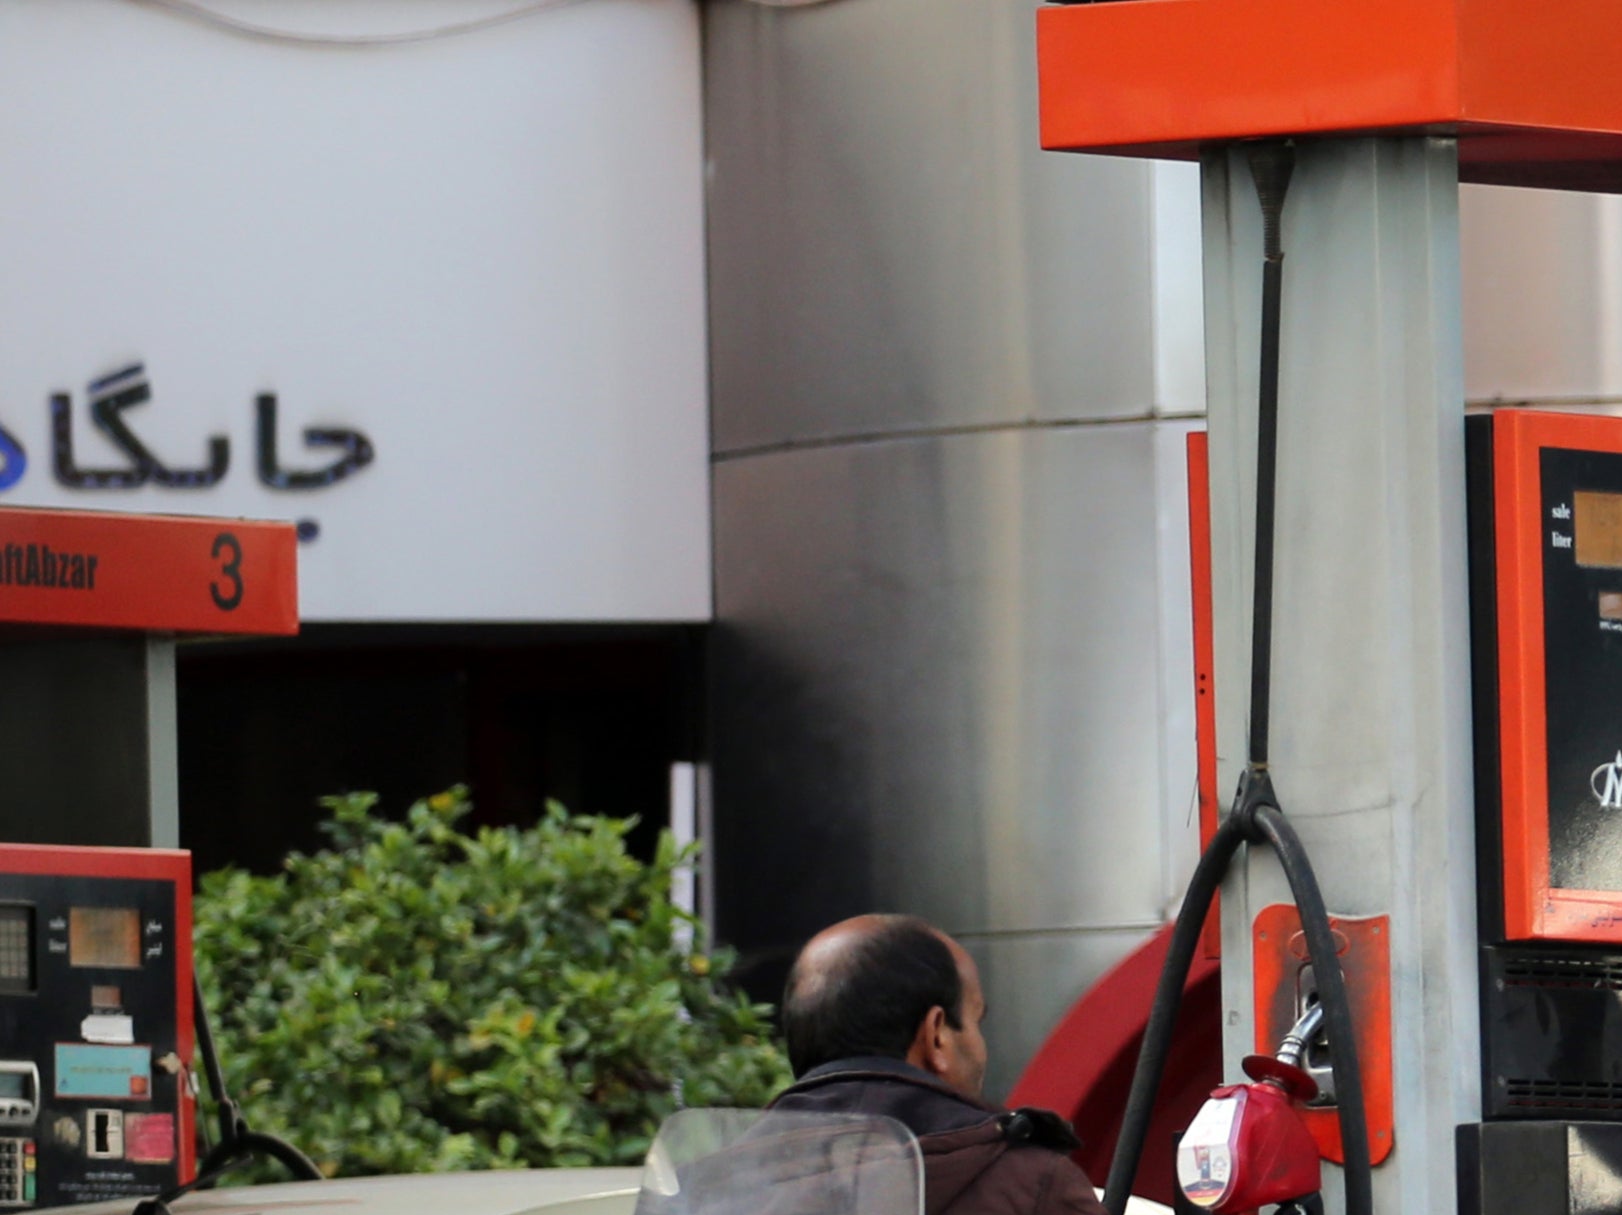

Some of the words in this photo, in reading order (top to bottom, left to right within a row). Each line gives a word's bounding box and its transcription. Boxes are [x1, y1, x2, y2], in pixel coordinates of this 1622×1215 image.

[1552, 503, 1571, 521] sale
[1552, 532, 1573, 550] liter
[209, 532, 243, 611] 3
